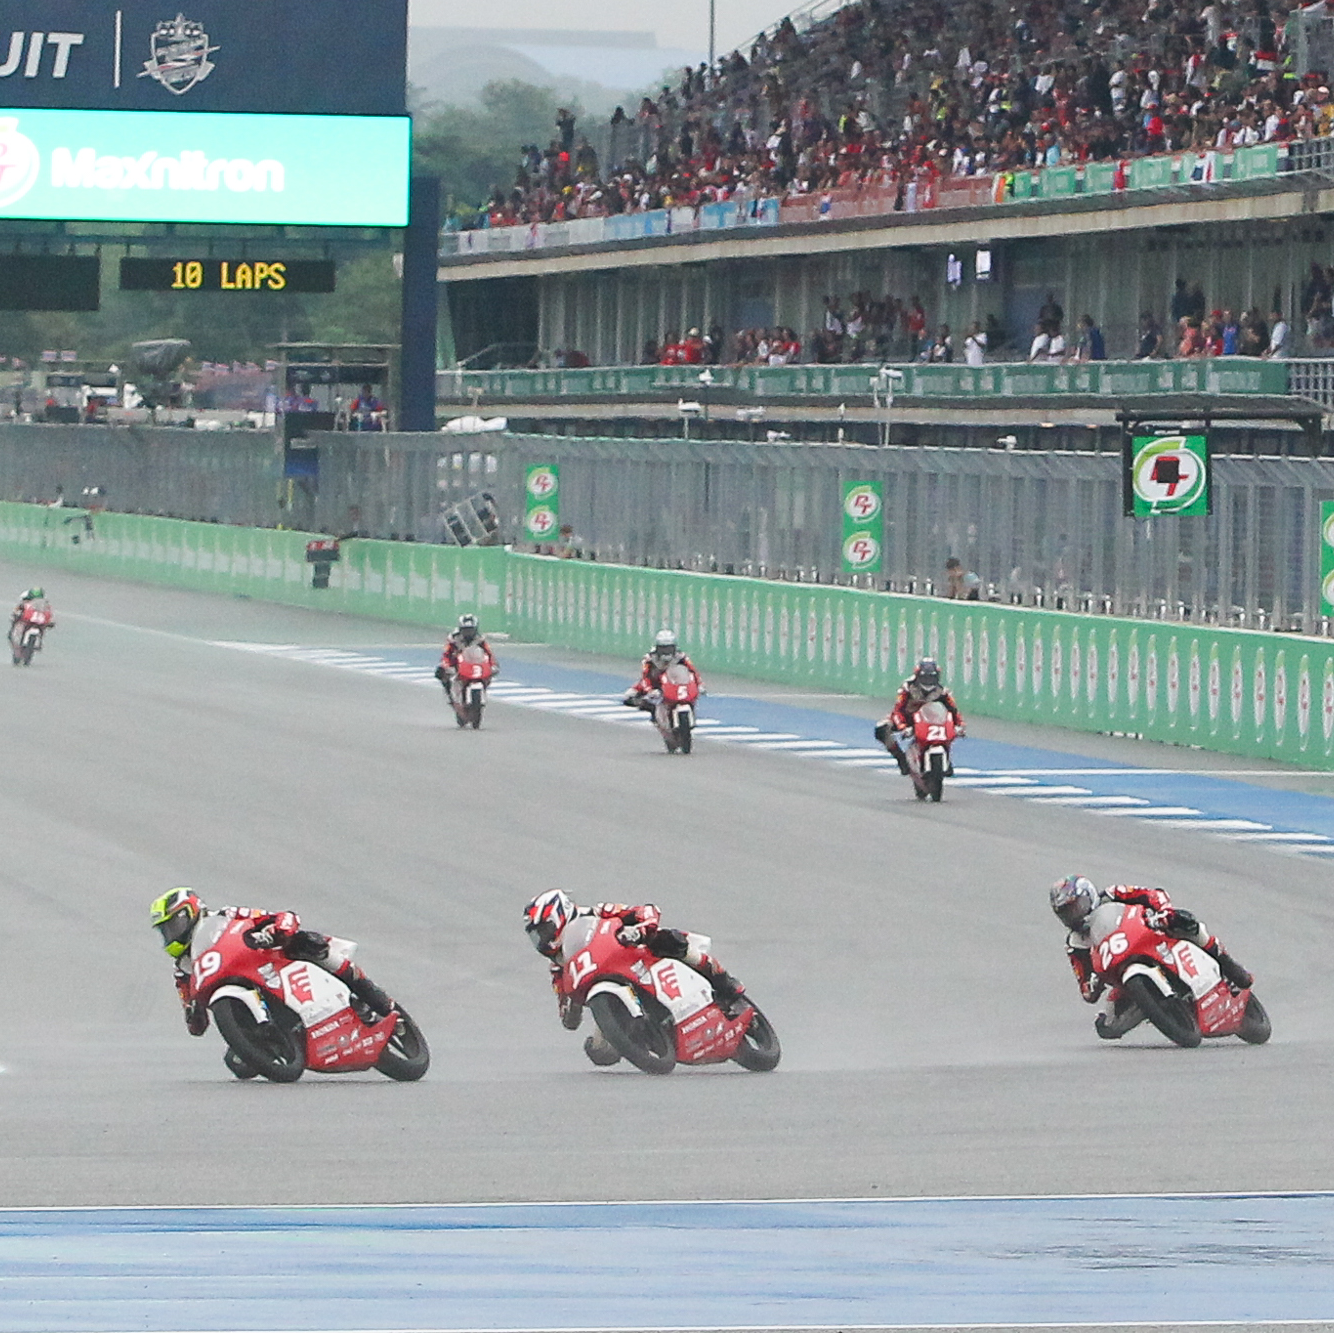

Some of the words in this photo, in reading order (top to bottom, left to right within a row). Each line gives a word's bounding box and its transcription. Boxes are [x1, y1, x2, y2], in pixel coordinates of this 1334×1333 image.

[171, 260, 203, 289] 10
[220, 262, 287, 290] LAPS
[471, 664, 482, 678] 3
[677, 685, 688, 700] 5
[926, 725, 947, 741] 21
[1099, 931, 1129, 971] 26
